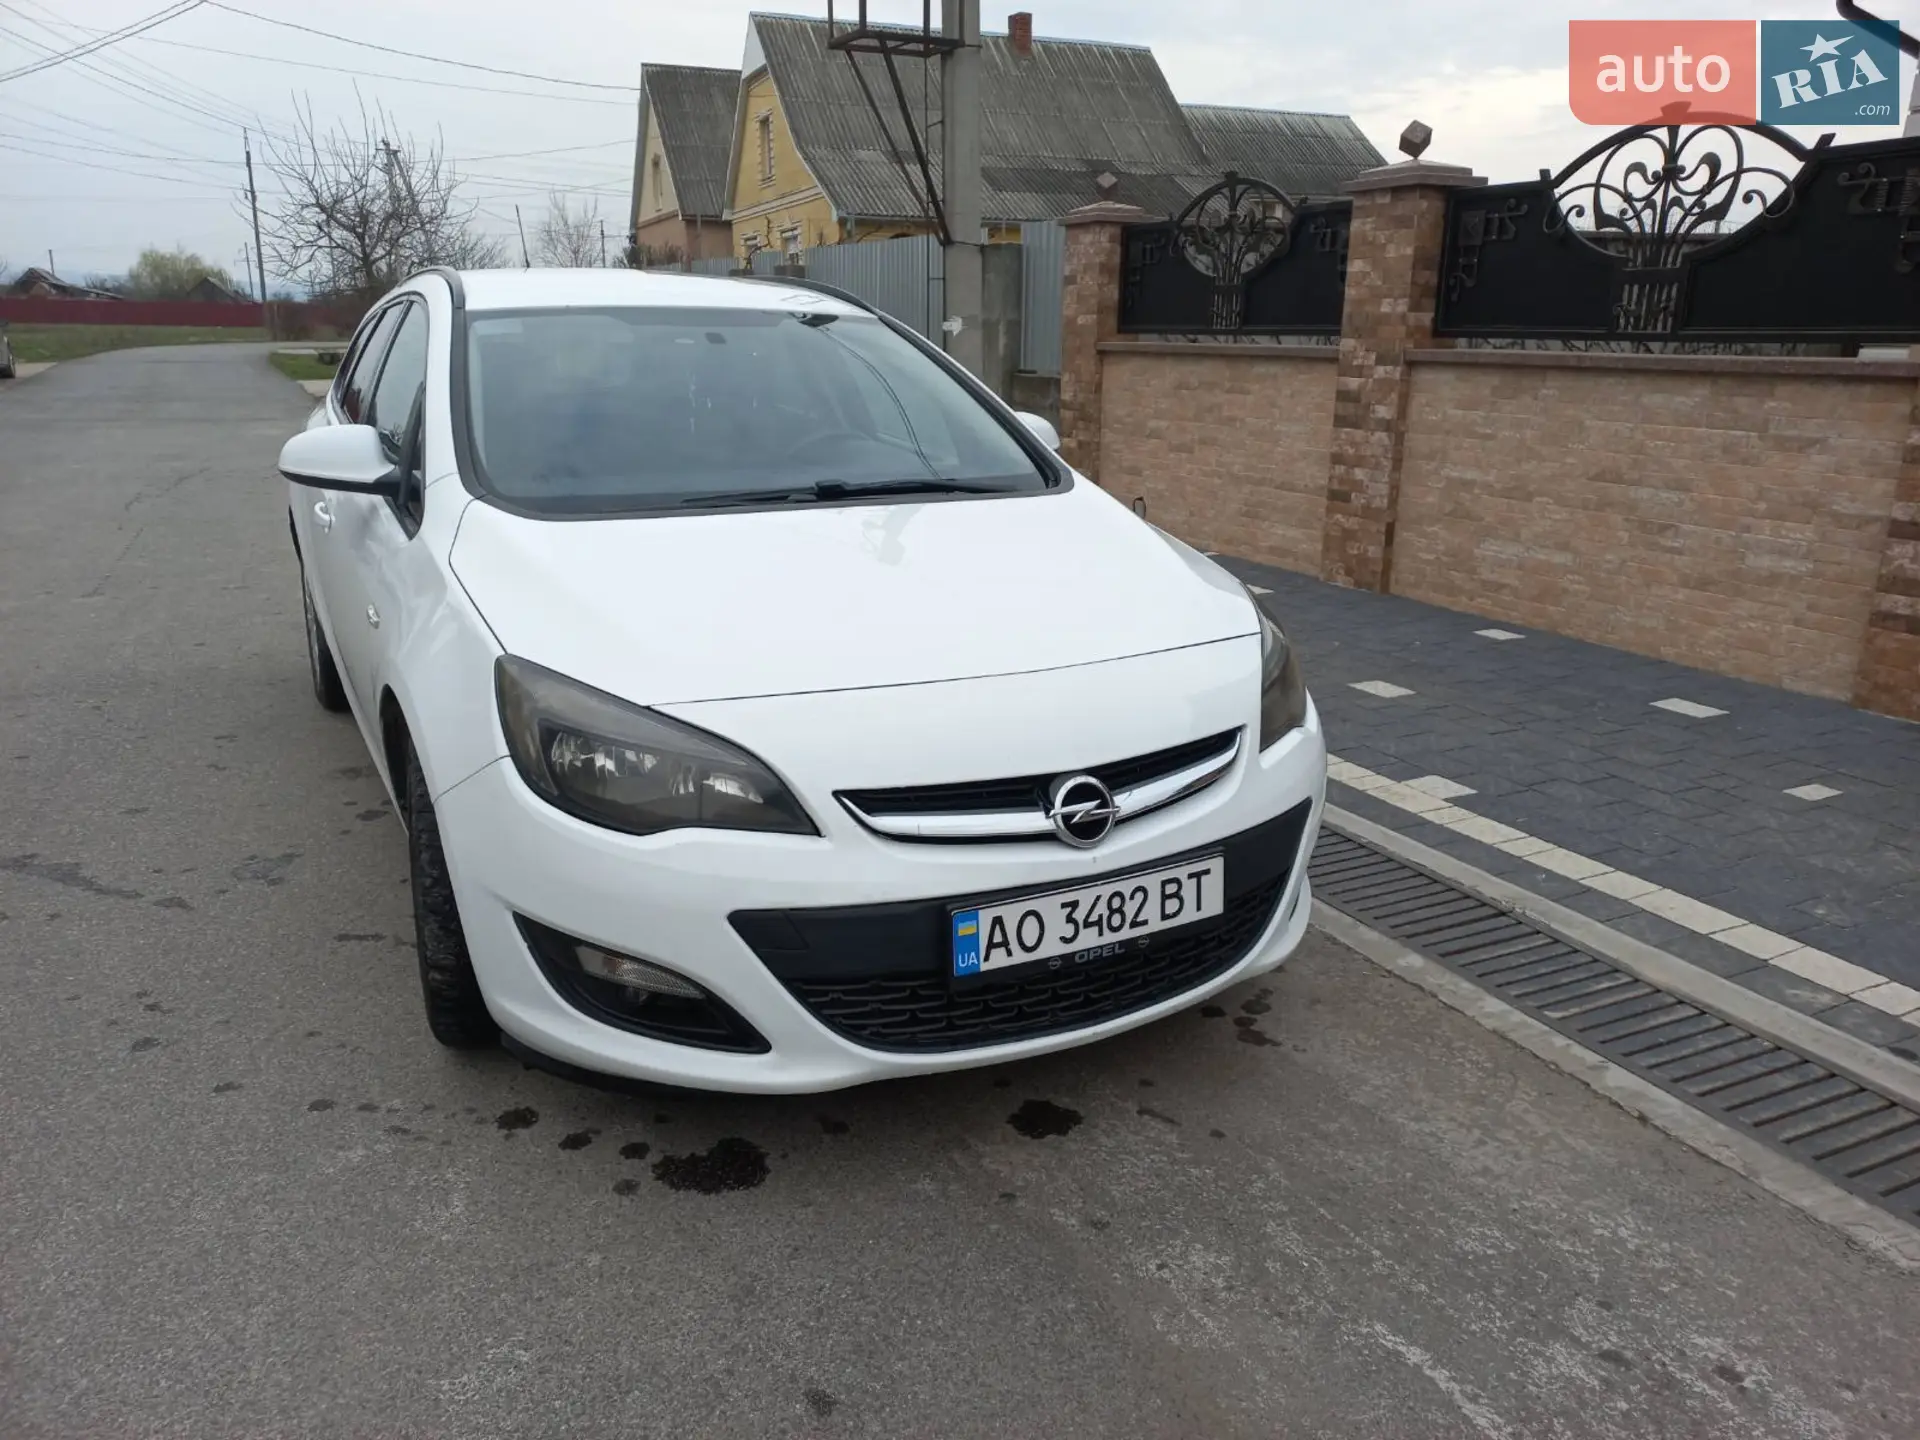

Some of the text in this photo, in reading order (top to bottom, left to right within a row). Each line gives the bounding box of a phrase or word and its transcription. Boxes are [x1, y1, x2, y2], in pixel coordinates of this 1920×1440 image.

[983, 868, 1211, 962] AO 3482 BT
[958, 953, 978, 967] UA
[1074, 944, 1125, 963] OPEL
